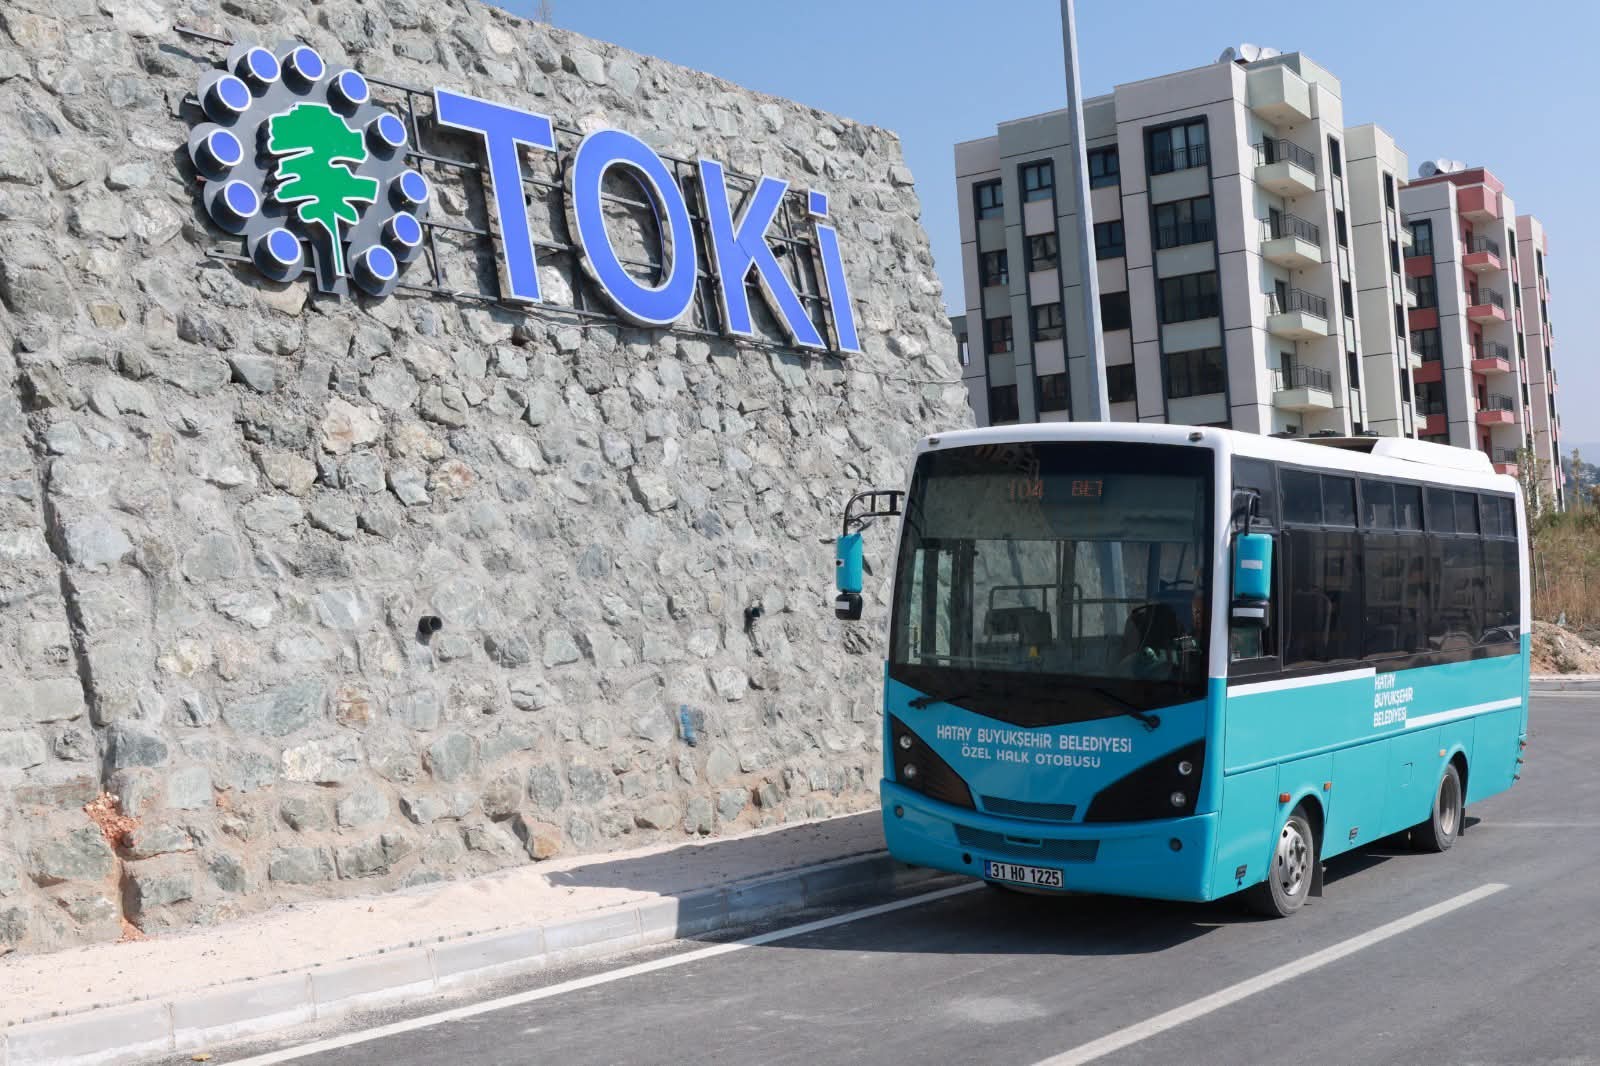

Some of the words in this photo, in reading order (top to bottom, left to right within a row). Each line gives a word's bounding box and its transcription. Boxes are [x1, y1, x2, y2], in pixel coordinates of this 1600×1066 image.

[1374, 673, 1396, 690] HATAY
[936, 725, 972, 741] HATAY
[961, 743, 992, 760] ÖZEL
[996, 750, 1030, 763] HALK
[992, 863, 1006, 878] 31
[1030, 868, 1060, 886] 1225
